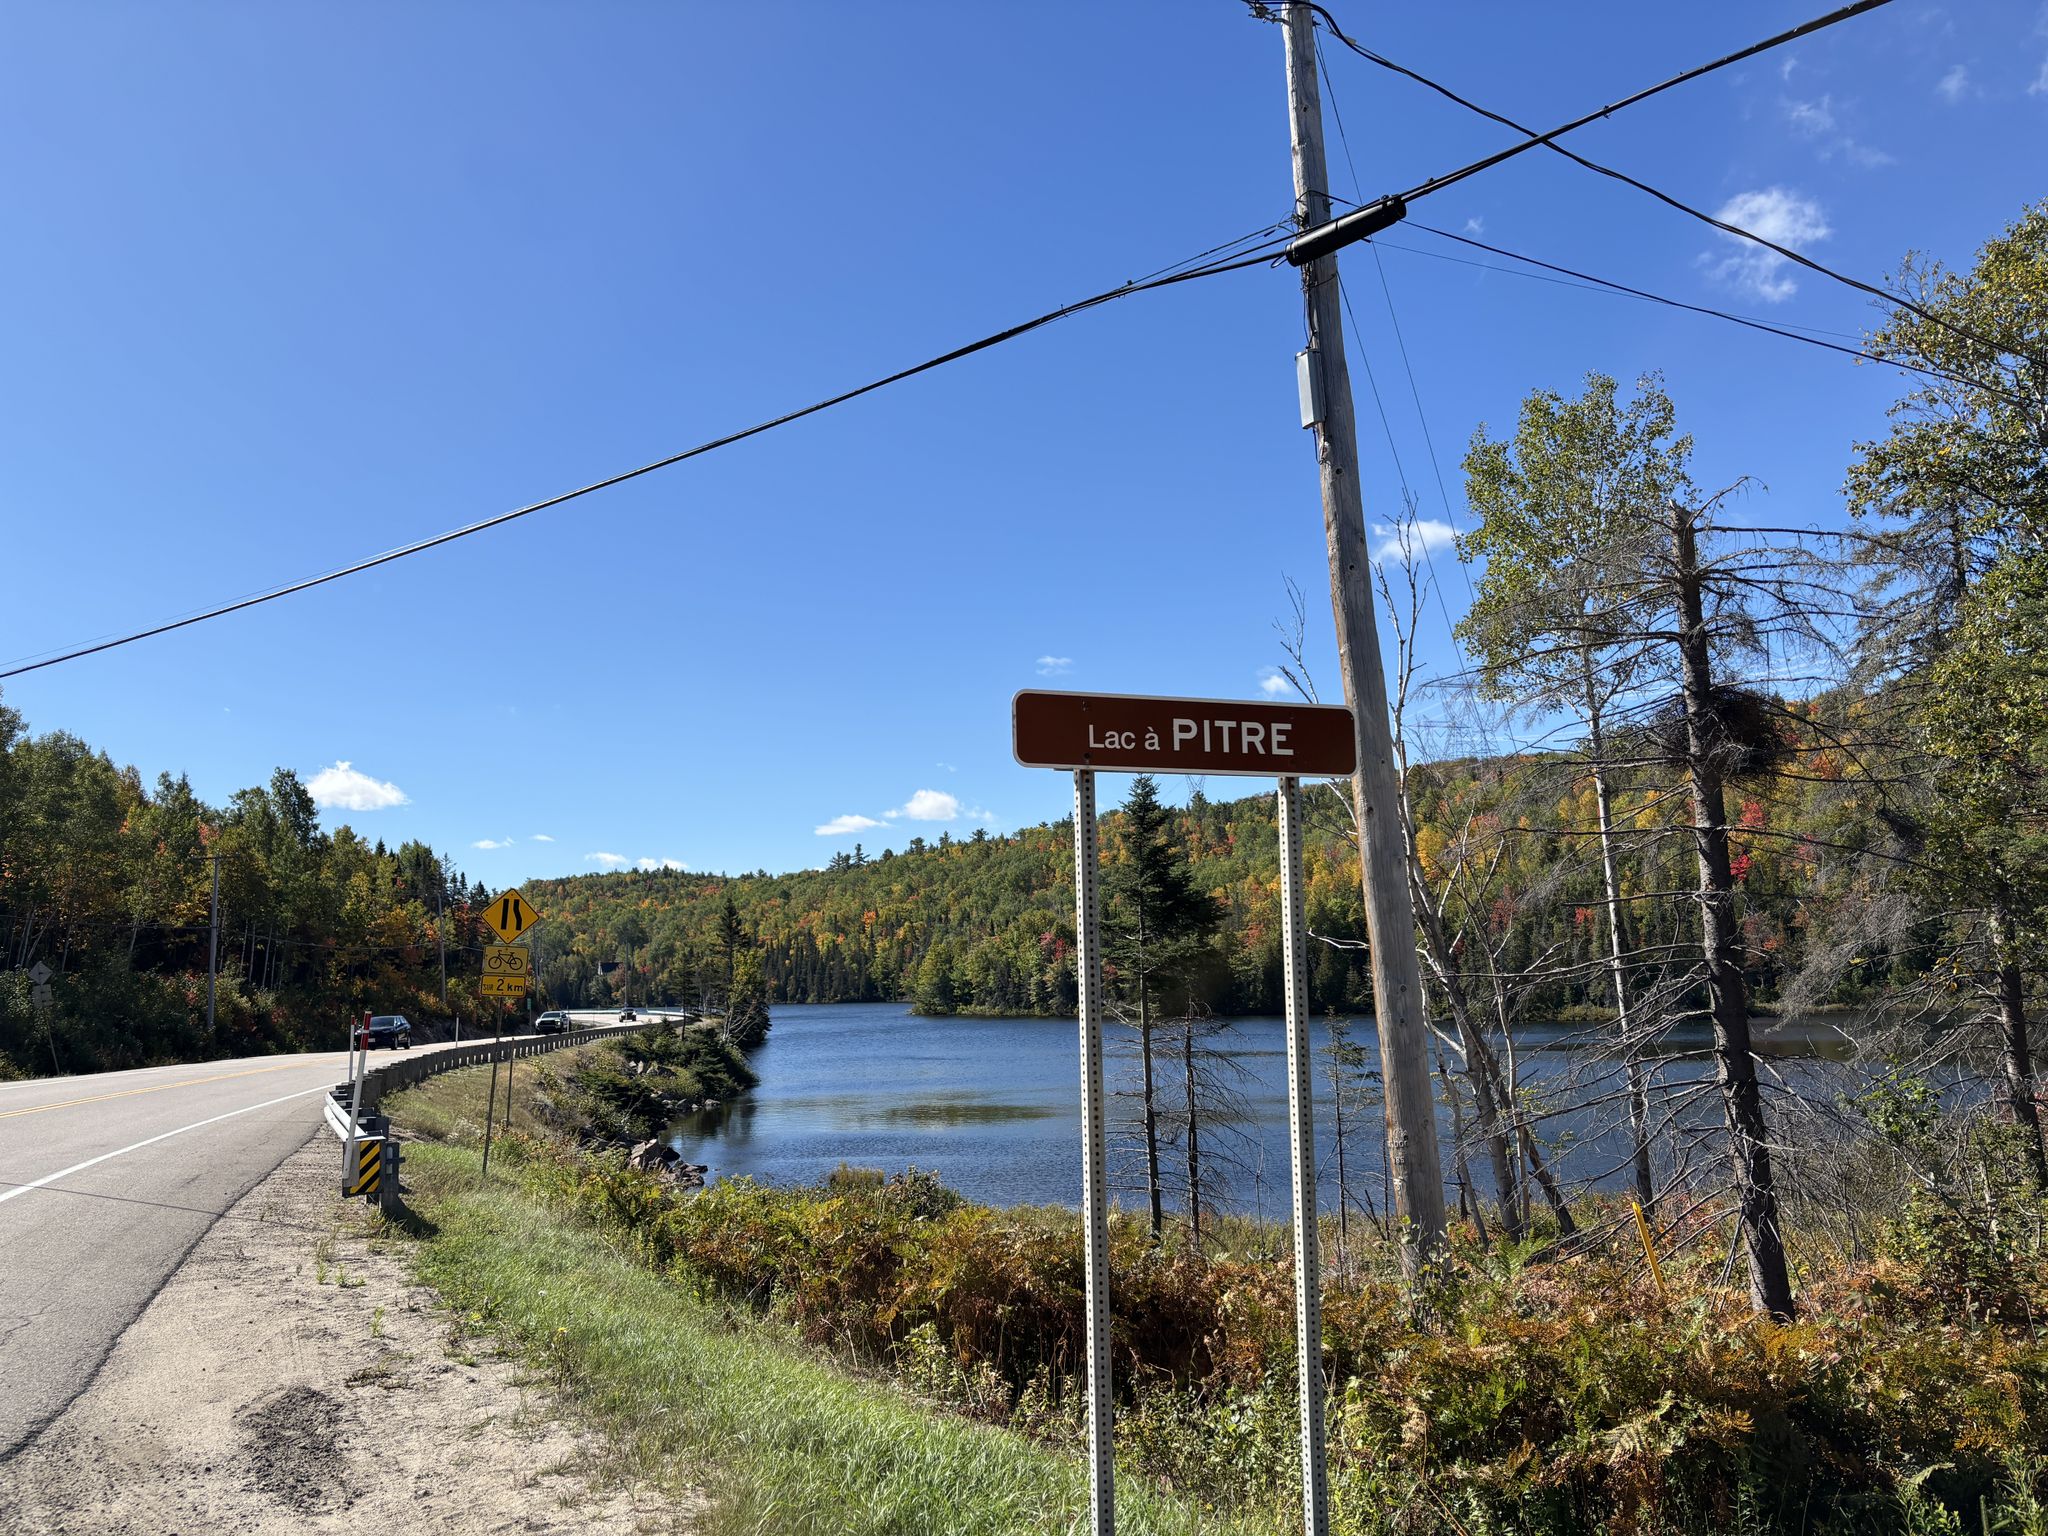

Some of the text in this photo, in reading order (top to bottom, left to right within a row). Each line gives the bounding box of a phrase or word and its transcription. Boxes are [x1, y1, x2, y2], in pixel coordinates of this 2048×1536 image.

[1089, 718, 1294, 755] Lac à PITRE
[496, 979, 504, 991] 2
[507, 983, 523, 991] km
